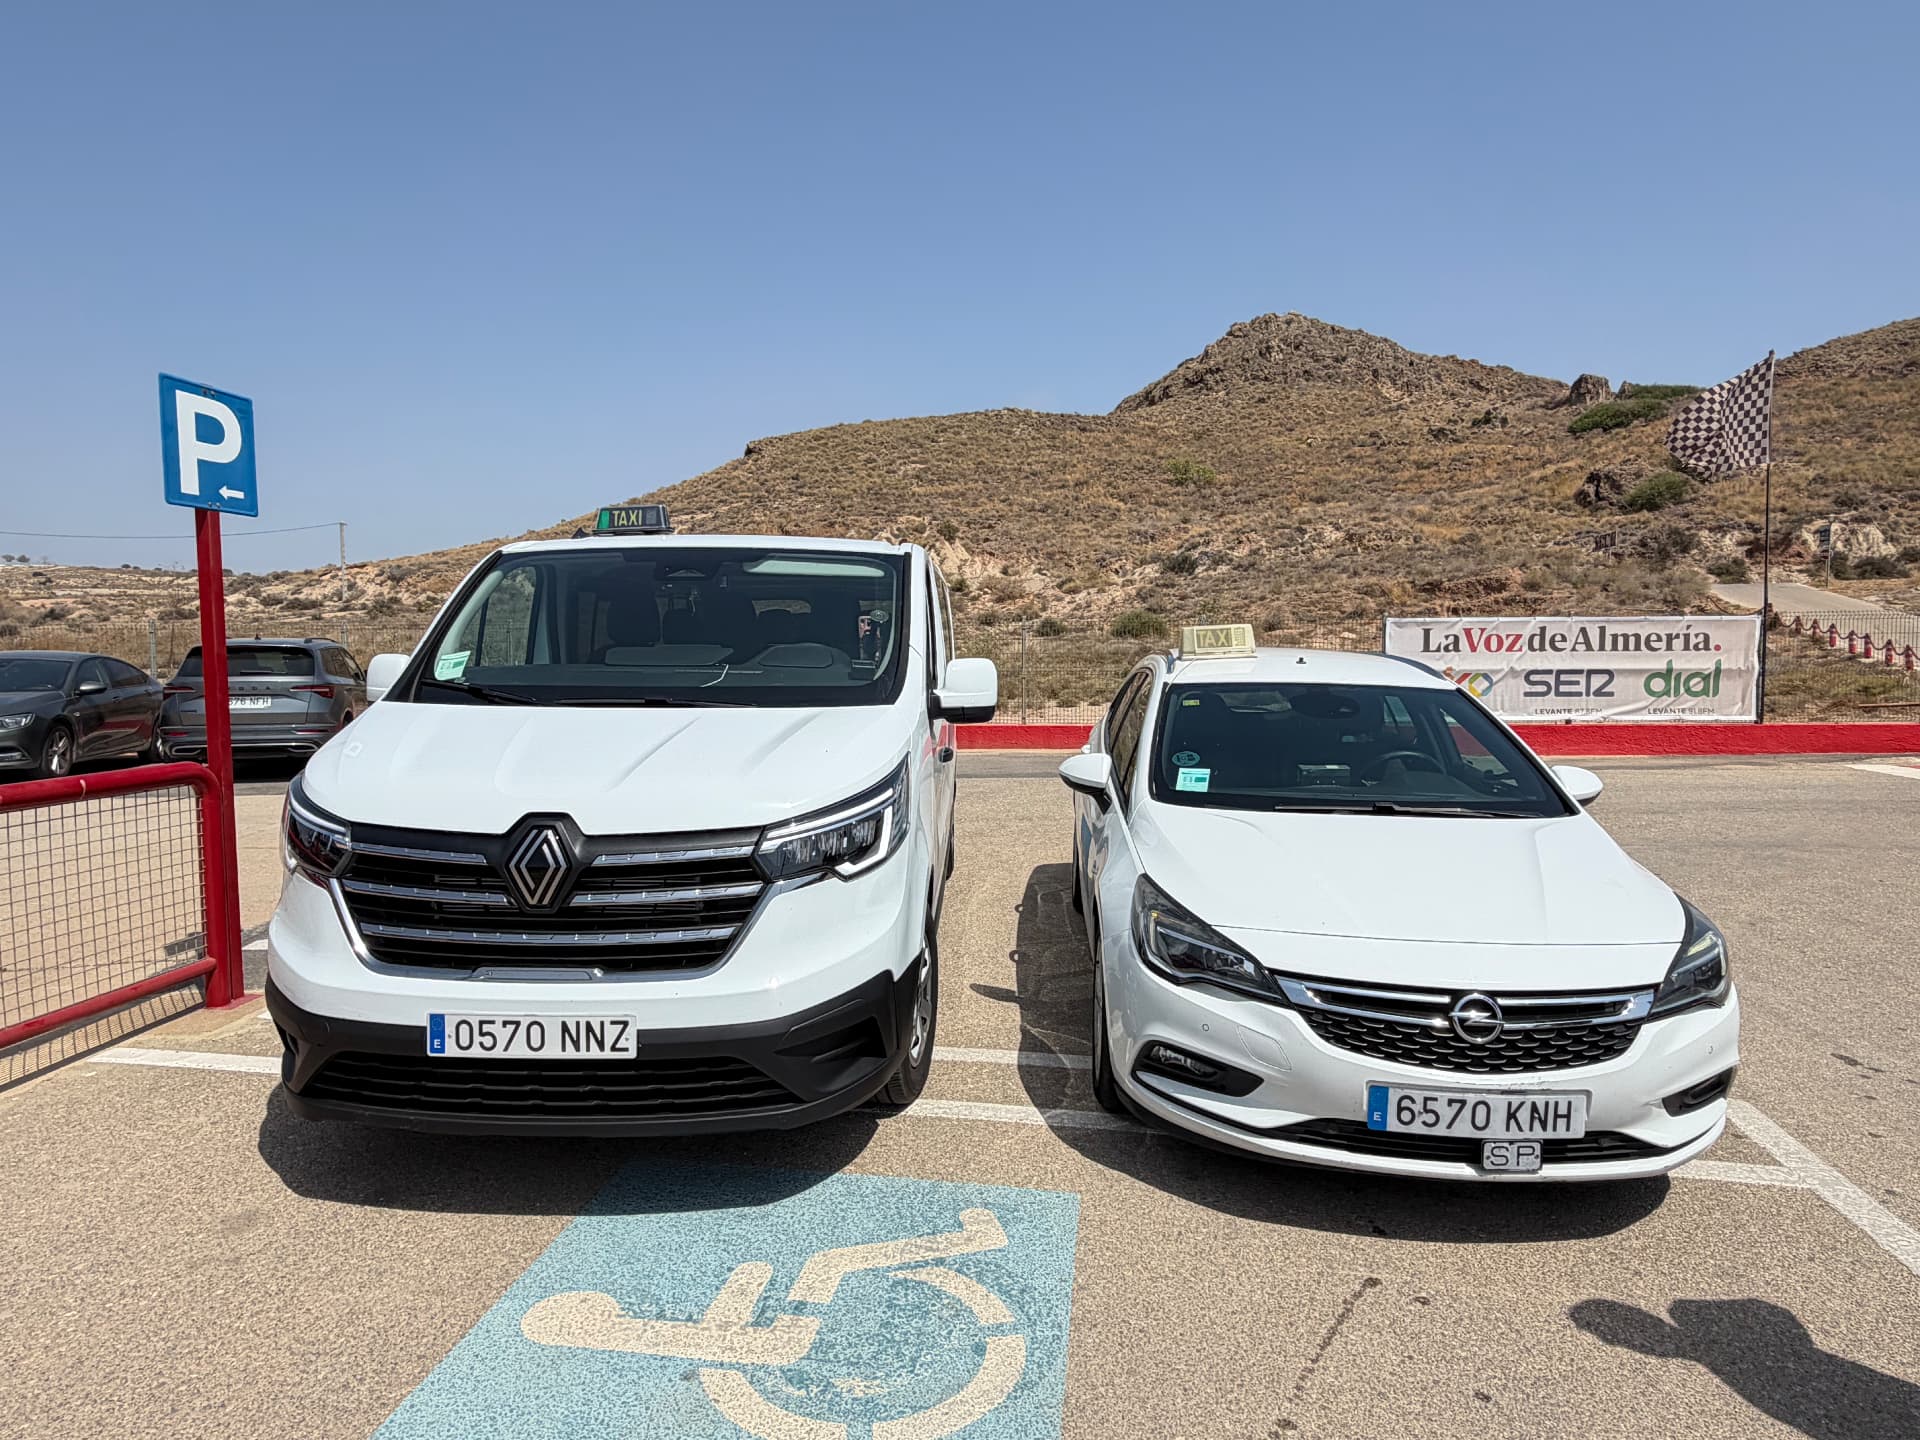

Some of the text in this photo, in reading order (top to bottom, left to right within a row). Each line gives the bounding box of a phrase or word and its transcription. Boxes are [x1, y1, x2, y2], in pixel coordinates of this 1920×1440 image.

[175, 389, 242, 496] P
[612, 509, 643, 527] TAXI
[1197, 629, 1232, 648] TAXI
[1523, 668, 1616, 698] SER
[1643, 658, 1723, 698] dial
[1647, 707, 1687, 715] LEVANTE
[434, 1019, 630, 1053] E 0570 NNZ
[1373, 1094, 1572, 1133] E 6570 KNH
[1490, 1145, 1536, 1167] SP
